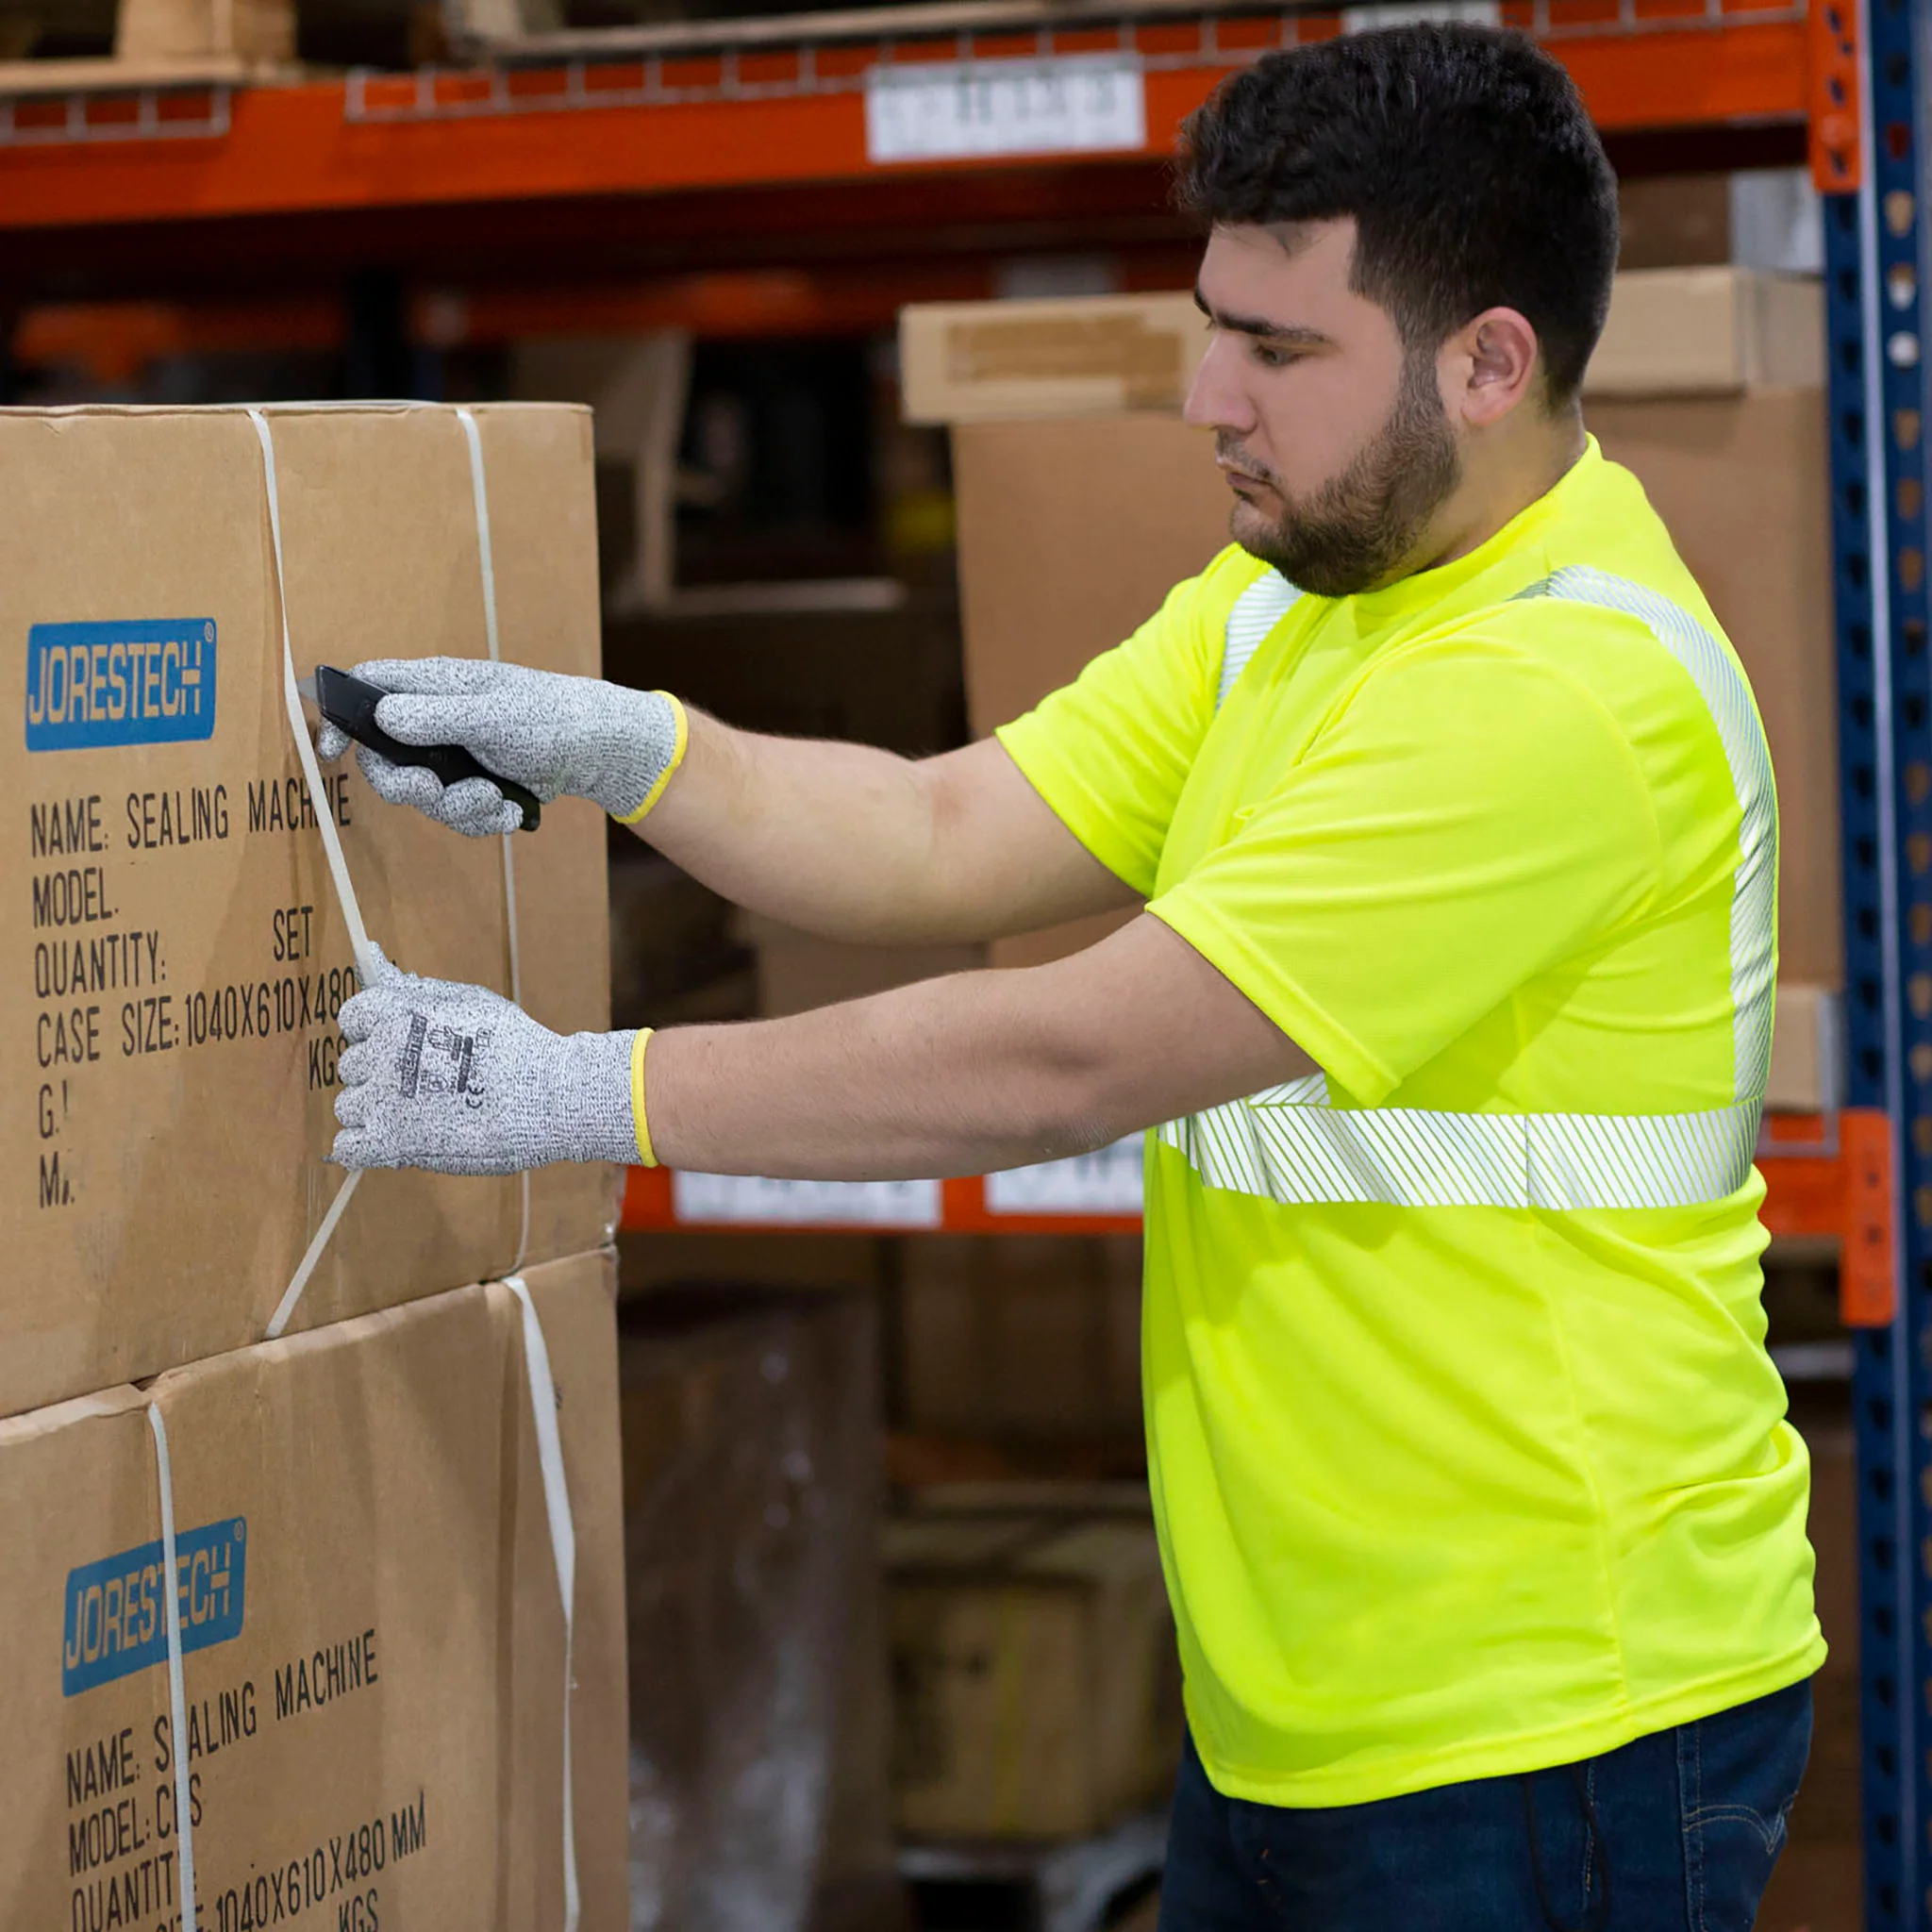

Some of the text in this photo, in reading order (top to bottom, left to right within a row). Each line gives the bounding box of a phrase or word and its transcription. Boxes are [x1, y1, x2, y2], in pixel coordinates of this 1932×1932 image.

[28, 641, 202, 725] JORESTECH
[31, 795, 109, 858] NAME:
[127, 784, 229, 849] SEALING
[35, 906, 313, 998] QUANTITY: SET
[37, 1007, 101, 1068] CASE
[67, 1628, 378, 1808] NAME: SALING MACHINE
[73, 1850, 197, 1932] QUANTIT:
